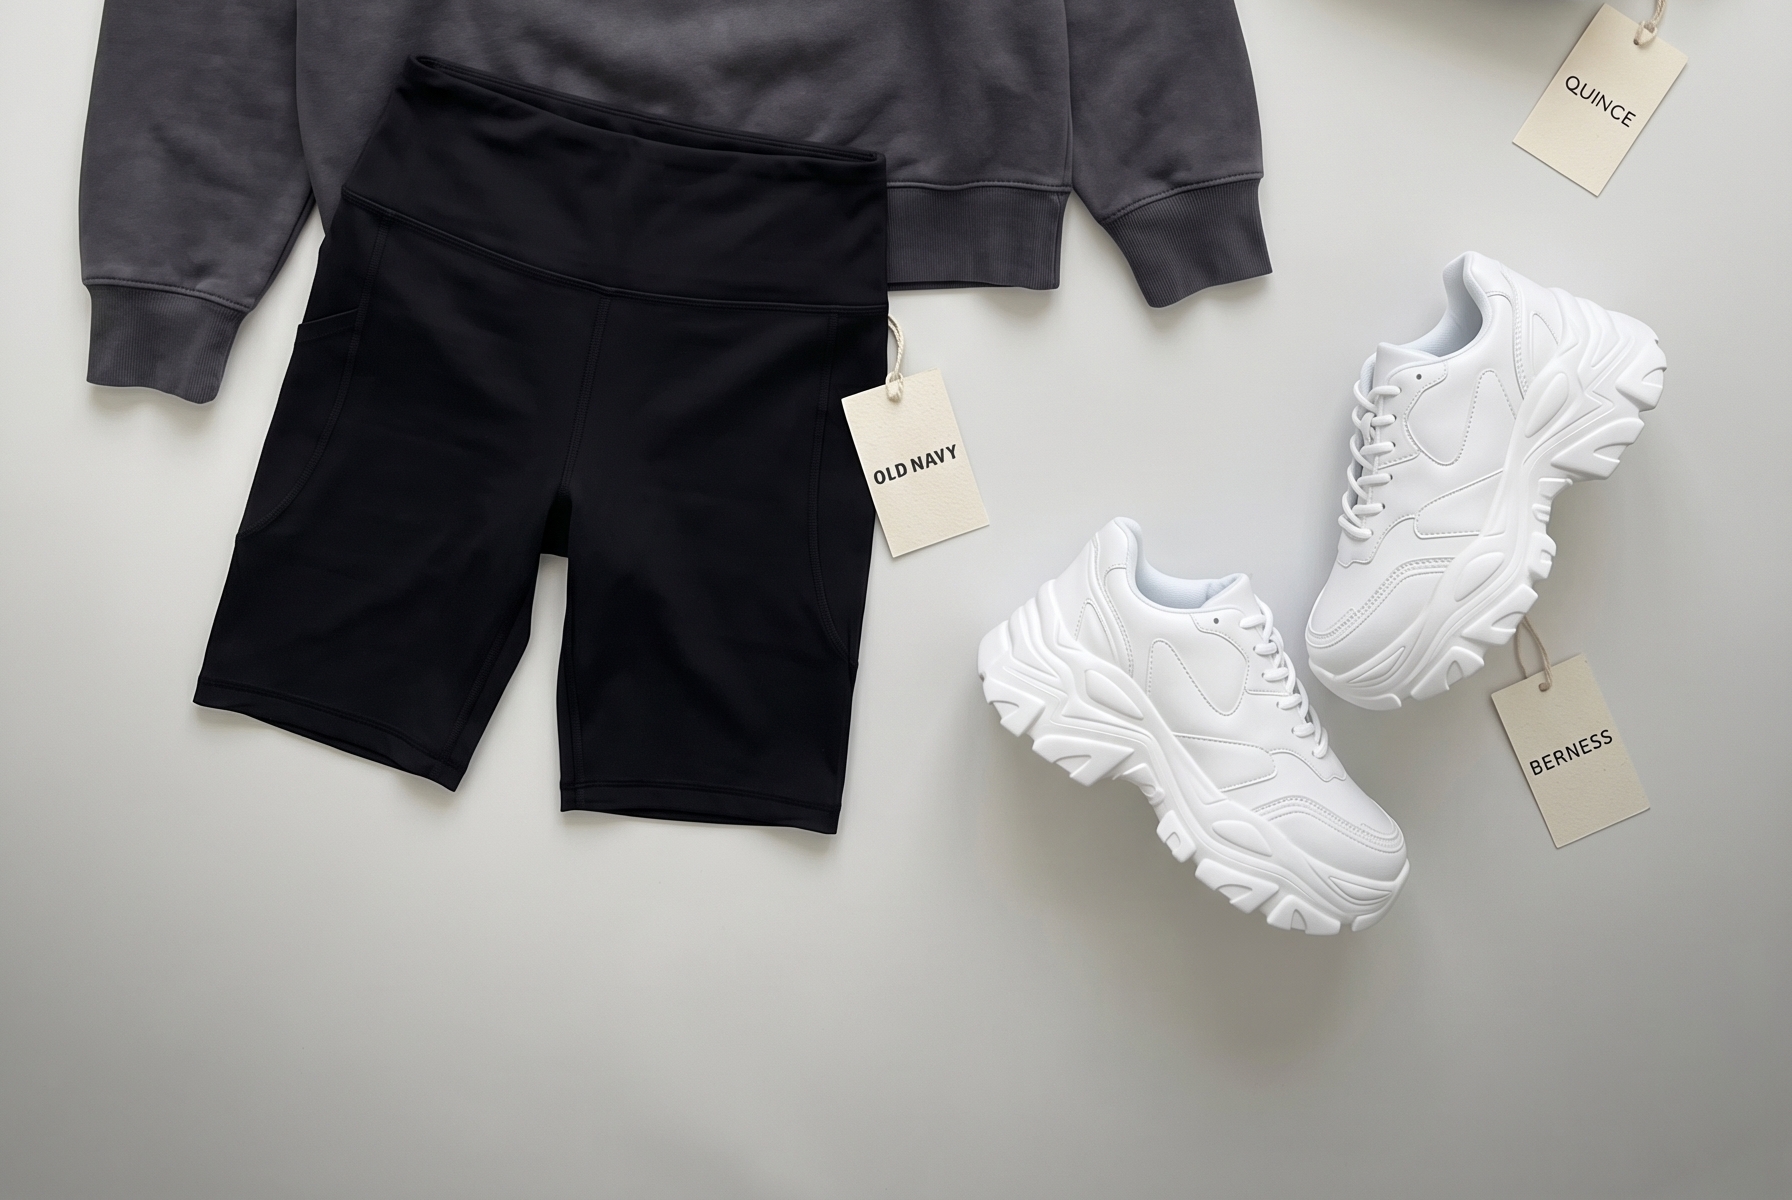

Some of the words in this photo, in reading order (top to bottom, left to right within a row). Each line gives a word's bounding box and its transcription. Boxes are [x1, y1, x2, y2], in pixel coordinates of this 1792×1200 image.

[1565, 75, 1636, 127] QUINCE
[873, 462, 907, 485] OLD
[910, 444, 957, 473] NAVY
[1529, 728, 1613, 775] BERNESS
